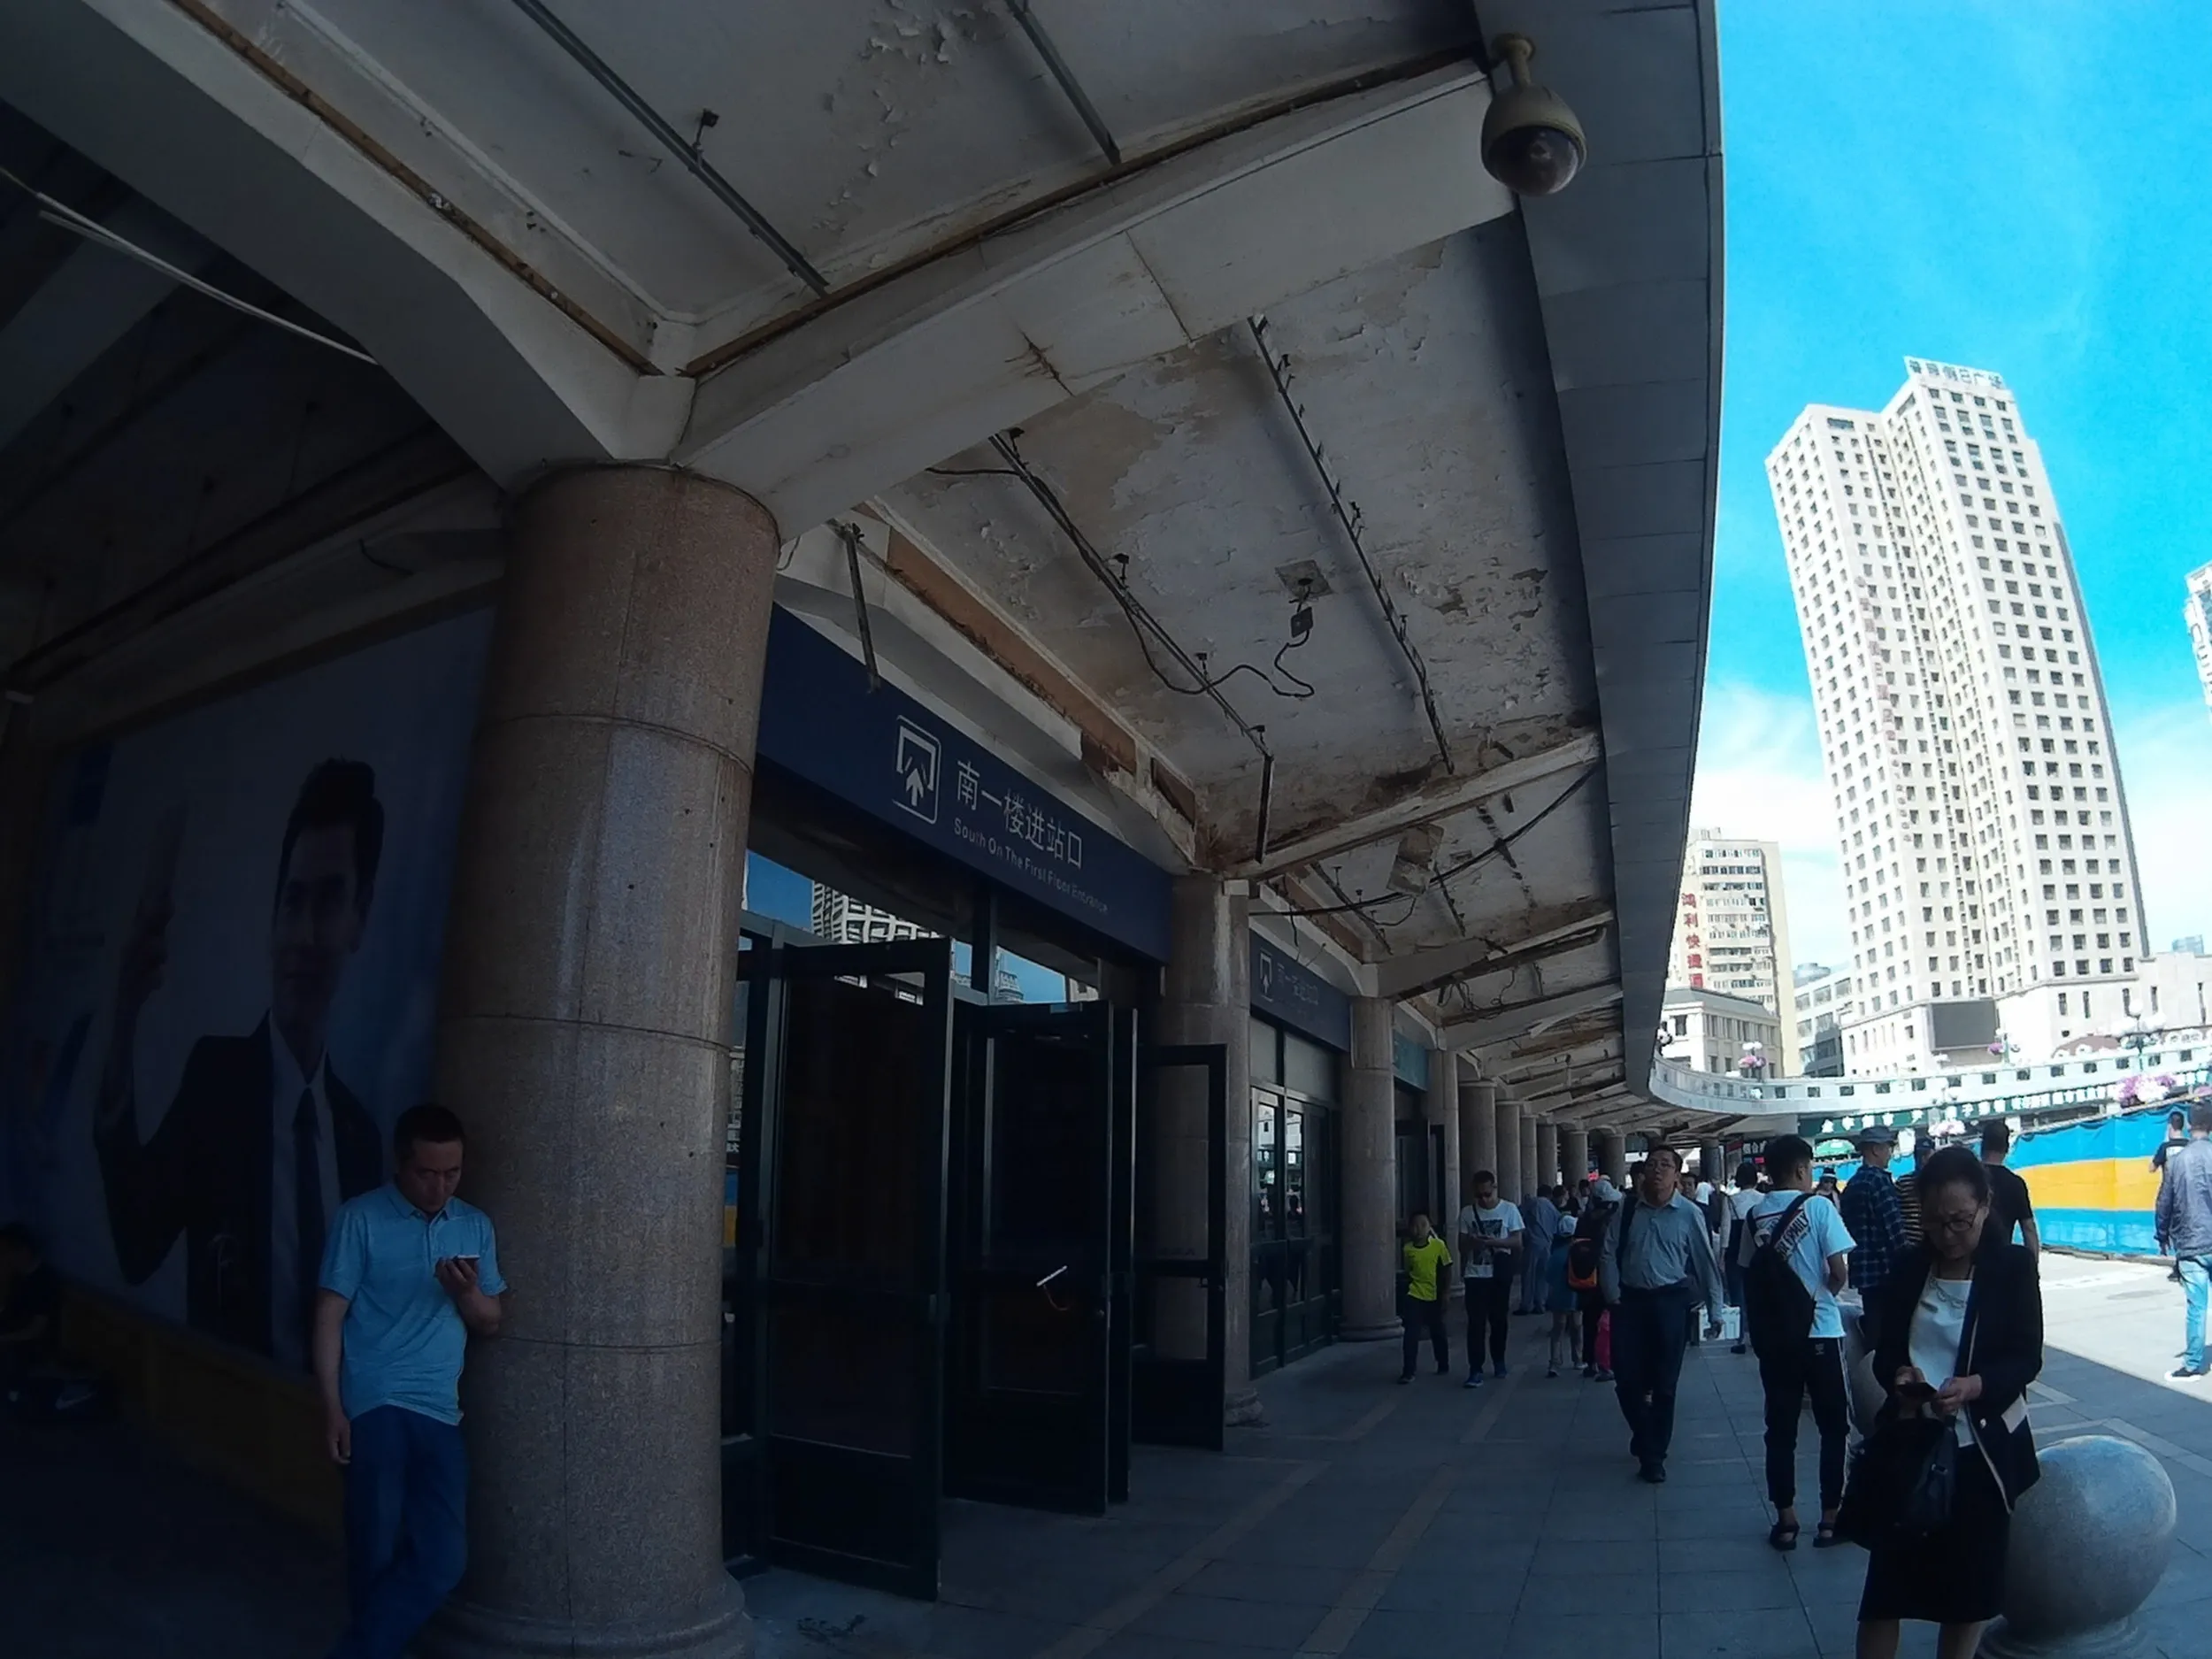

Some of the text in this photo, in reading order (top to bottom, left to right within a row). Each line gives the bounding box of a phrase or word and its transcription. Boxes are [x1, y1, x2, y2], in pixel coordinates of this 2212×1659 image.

[954, 817, 986, 848] South
[988, 837, 1003, 860] On
[1005, 846, 1023, 870] The
[1025, 856, 1047, 883] First
[956, 760, 1082, 870] 南一楼进站口
